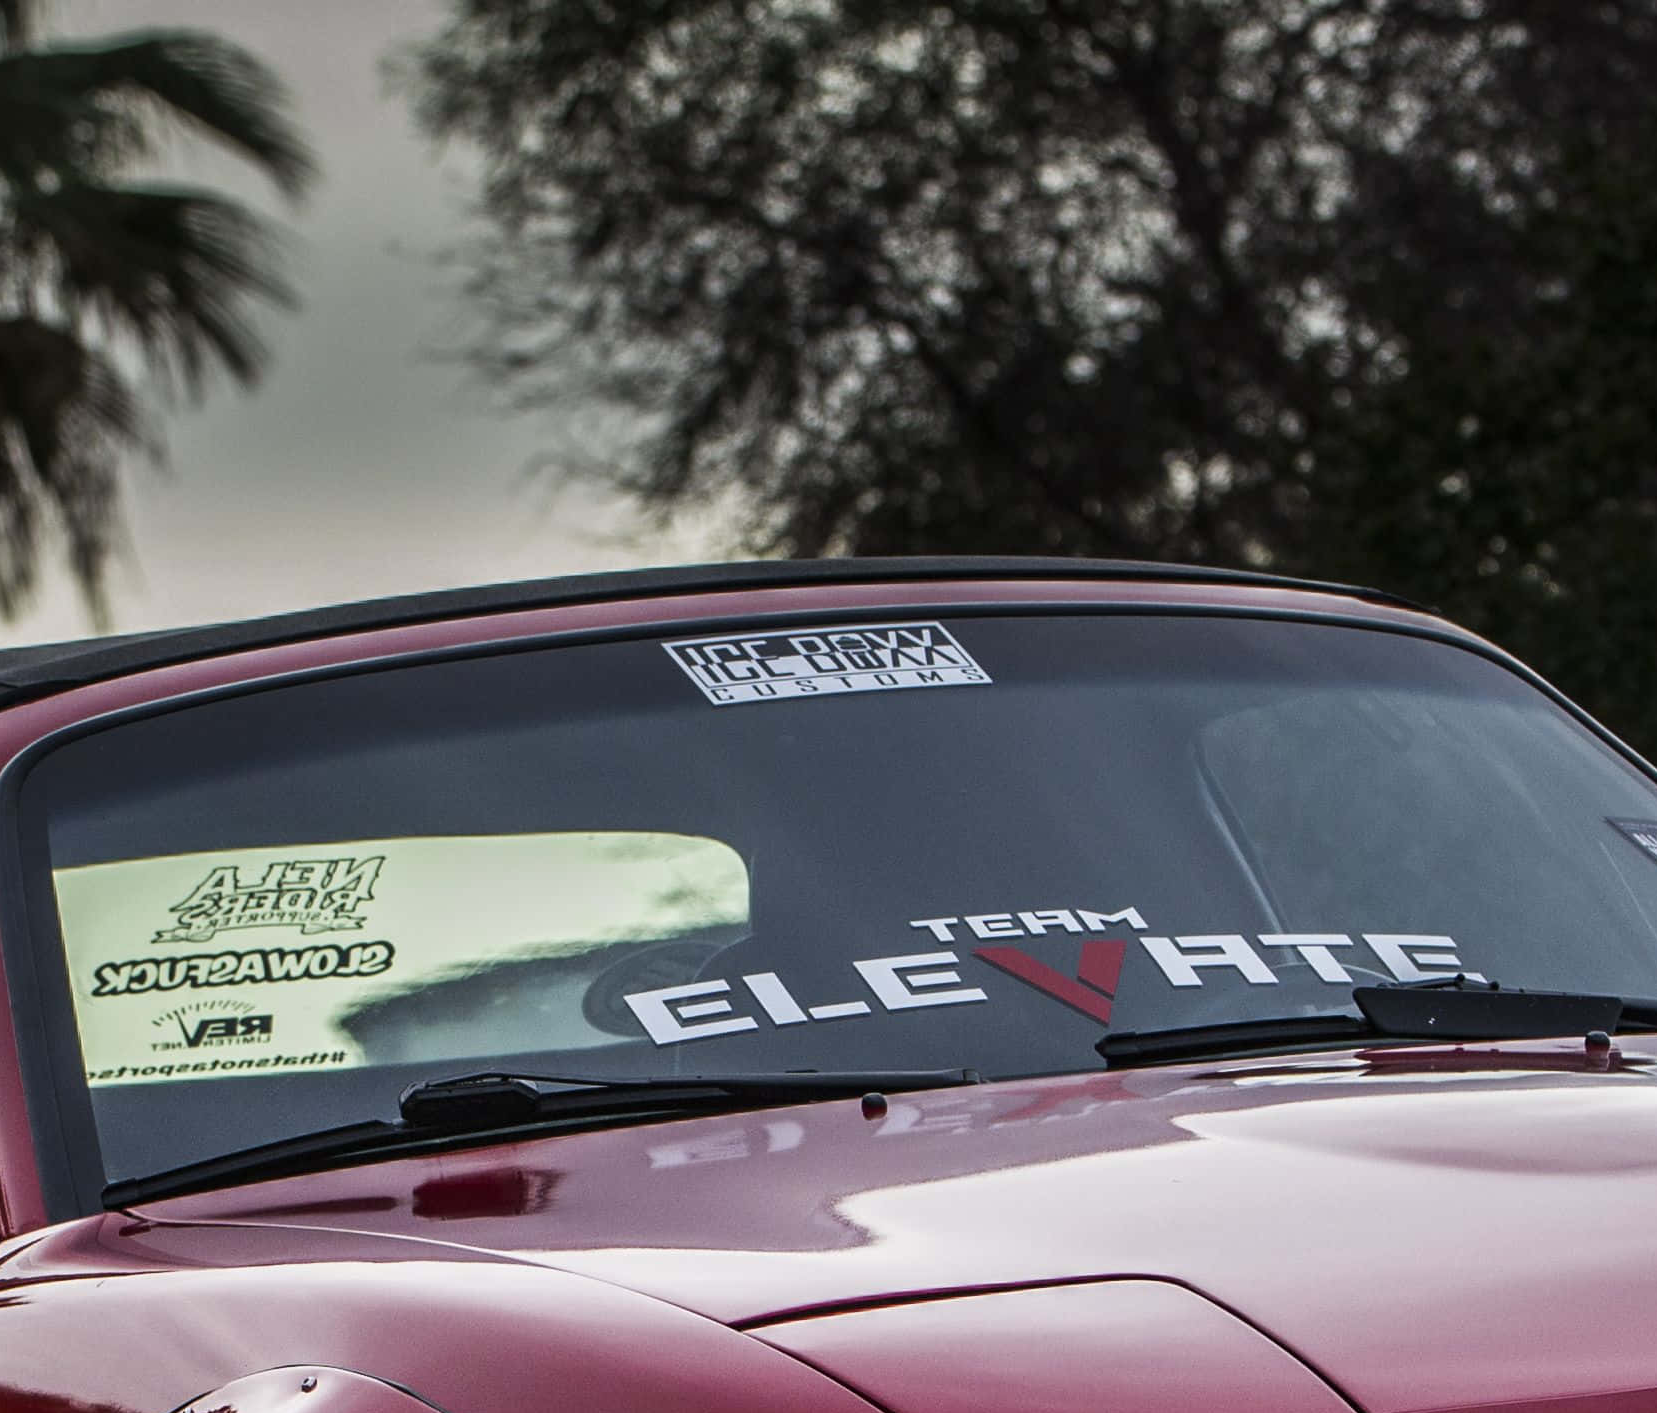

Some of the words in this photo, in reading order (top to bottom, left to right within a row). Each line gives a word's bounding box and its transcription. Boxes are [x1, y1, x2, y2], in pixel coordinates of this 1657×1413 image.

[711, 666, 984, 702] CUSTOMS
[909, 906, 1148, 942] TEAM
[622, 931, 1487, 1046] ELEVATE
